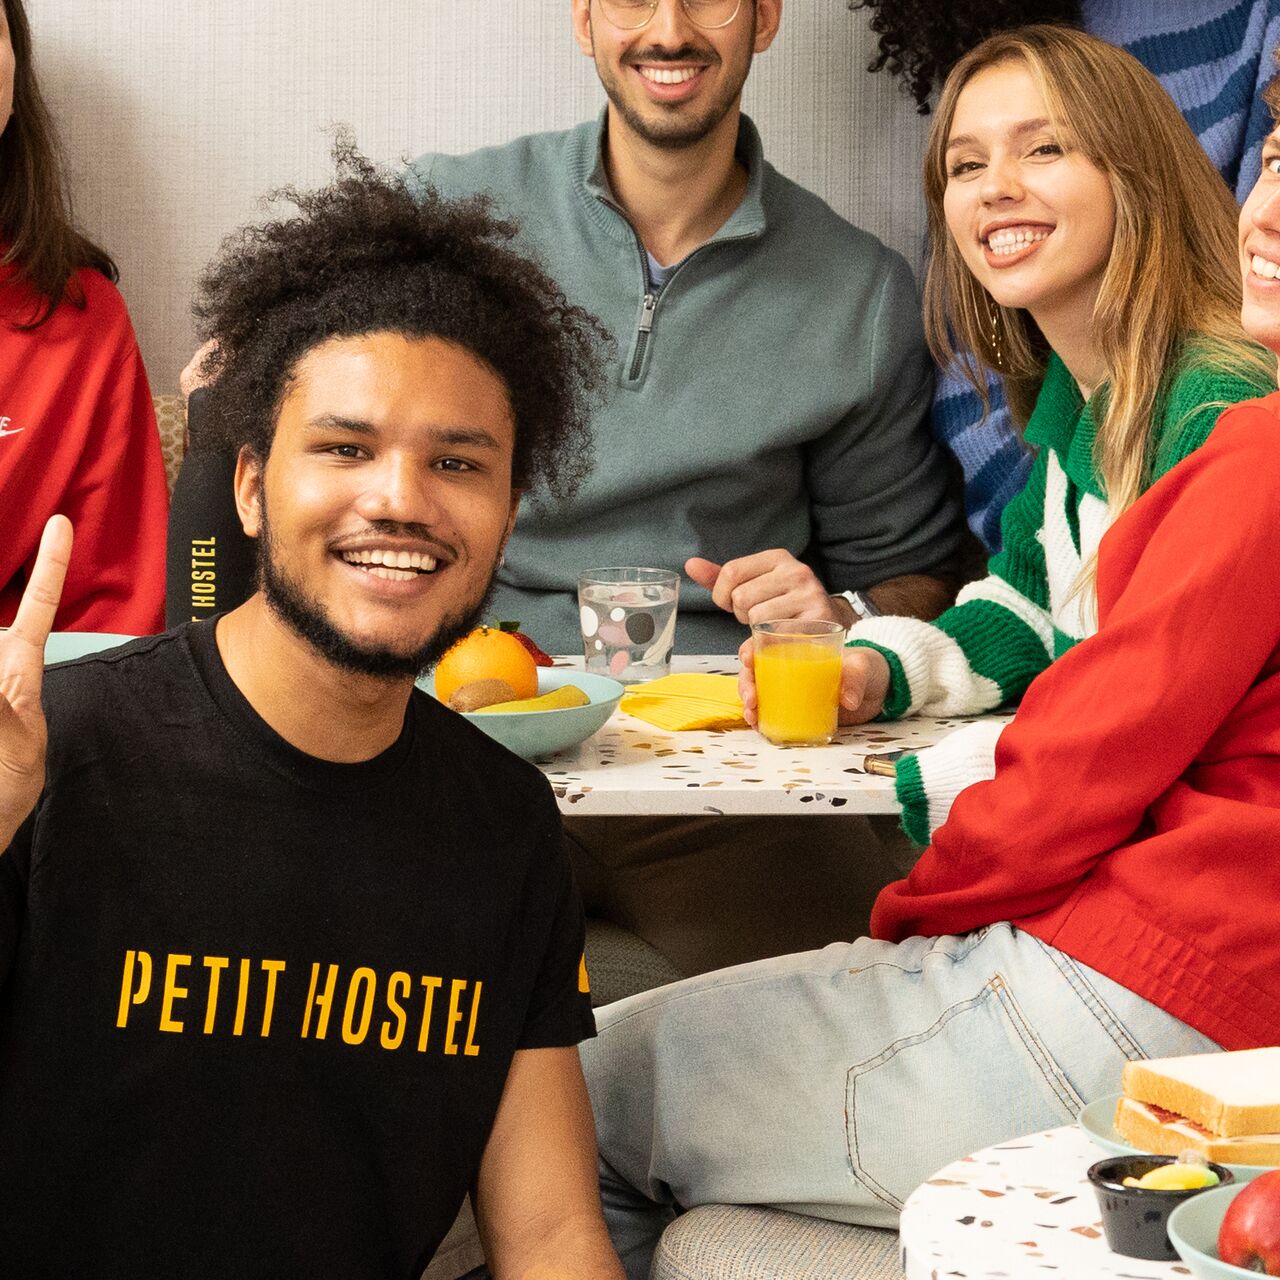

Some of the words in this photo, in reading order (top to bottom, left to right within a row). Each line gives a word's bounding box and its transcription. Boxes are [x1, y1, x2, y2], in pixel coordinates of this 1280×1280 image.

[191, 536, 216, 608] HOSTEL
[116, 950, 286, 1038] PETIT
[300, 962, 483, 1057] HOSTEL
